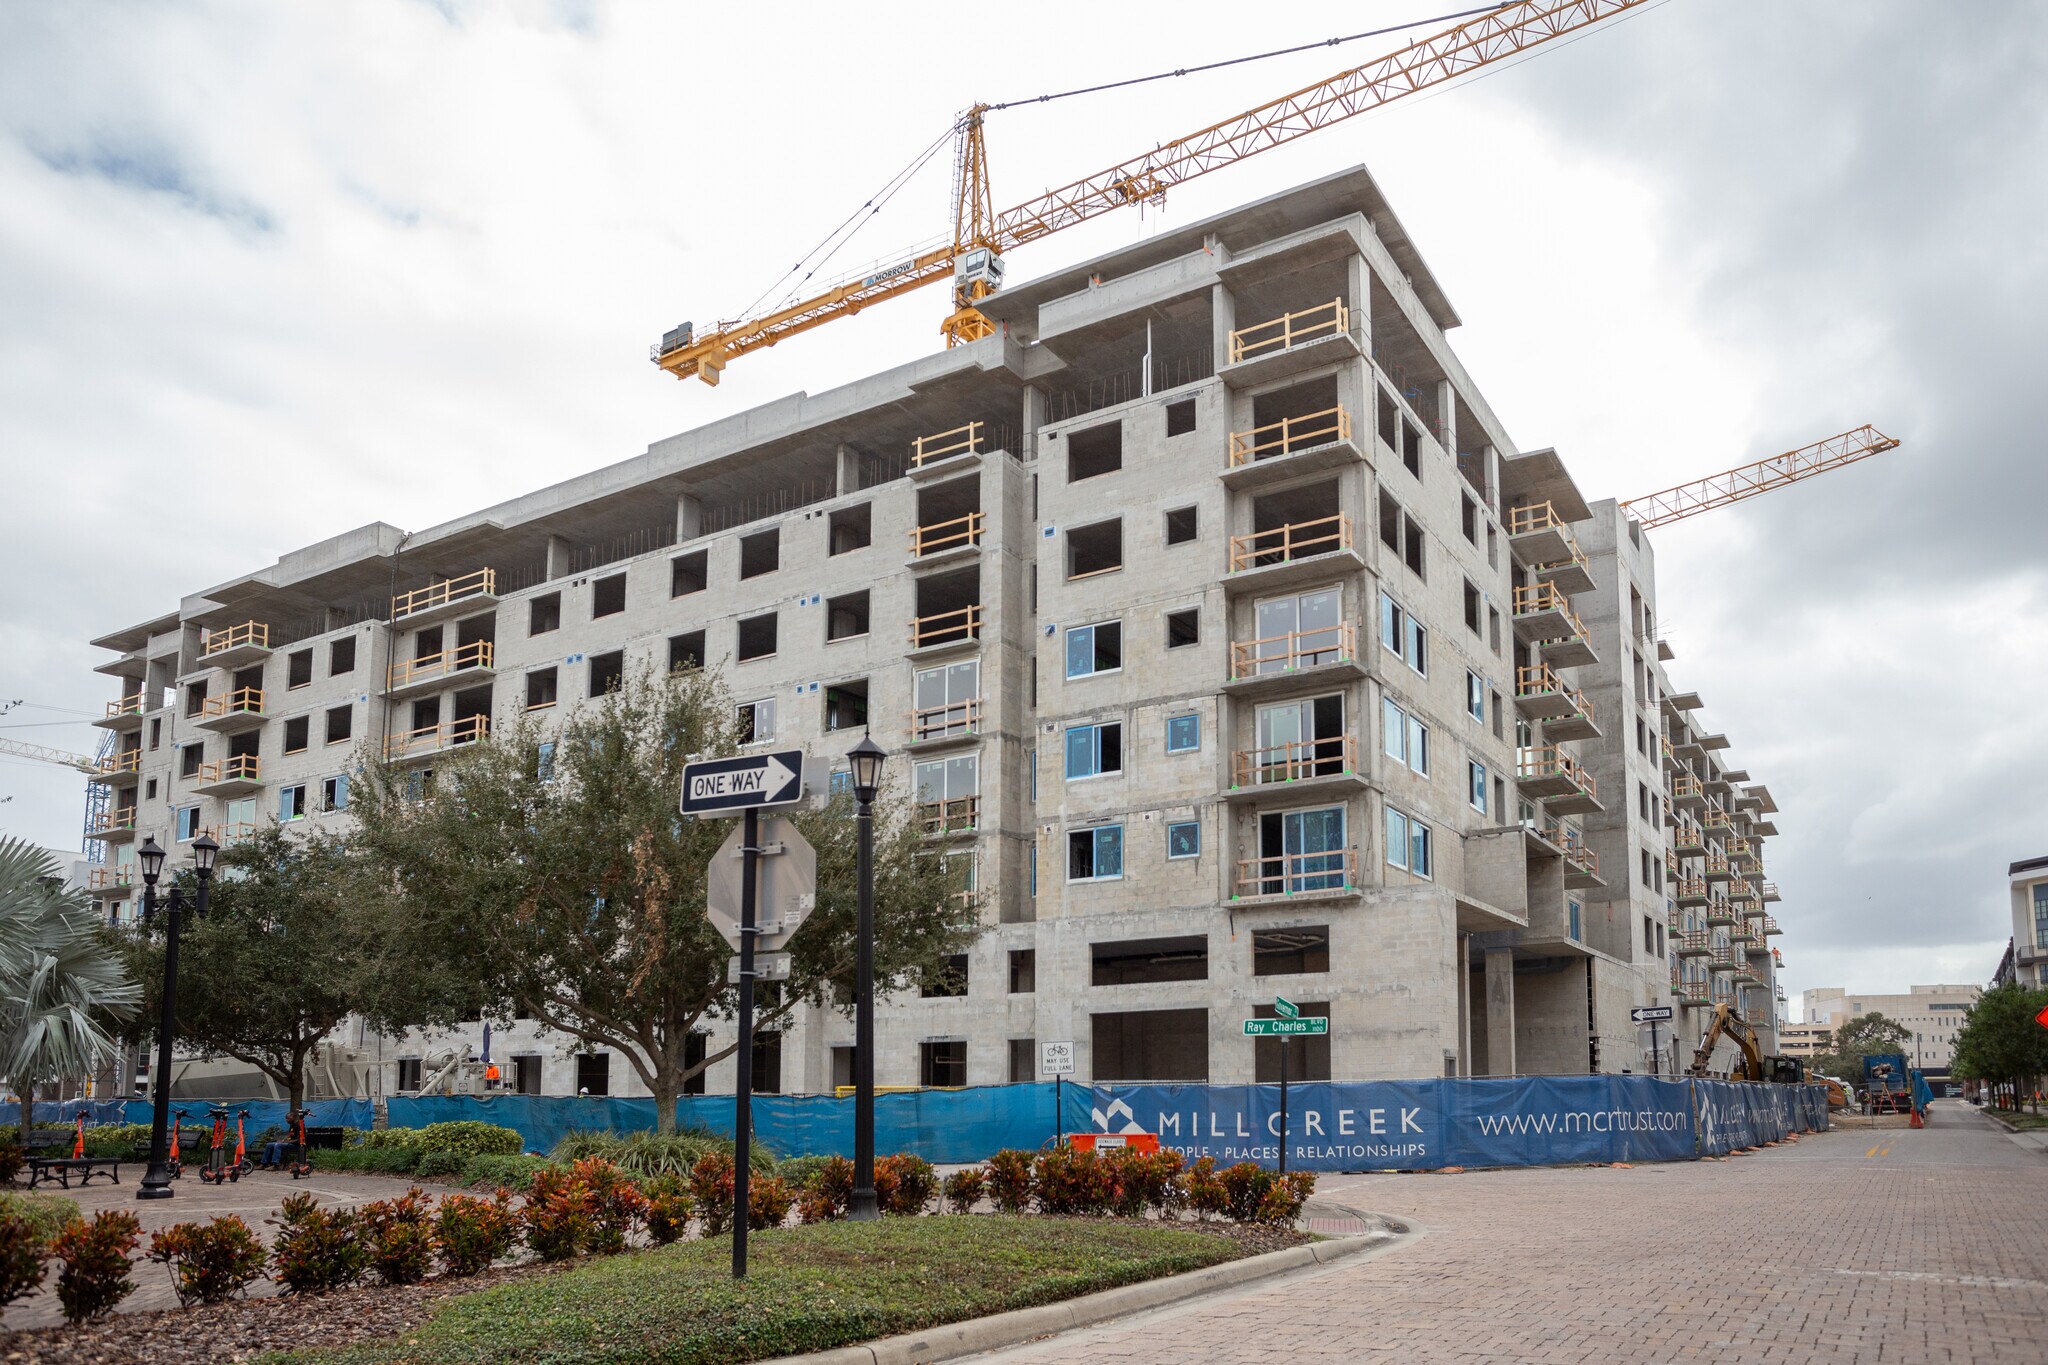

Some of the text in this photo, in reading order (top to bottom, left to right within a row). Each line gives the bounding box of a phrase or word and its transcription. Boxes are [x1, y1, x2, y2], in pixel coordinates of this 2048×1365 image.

[875, 263, 911, 283] MORROW
[695, 770, 765, 797] ONE WAY
[1247, 1022, 1265, 1034] Ray
[1272, 1021, 1307, 1032] Charles
[1159, 1108, 1424, 1137] MILL CREEK
[1477, 1106, 1687, 1136] www.mcrtrust.com
[1225, 1146, 1279, 1159] PLACES
[1296, 1143, 1427, 1159] RELATIONSHIPS
